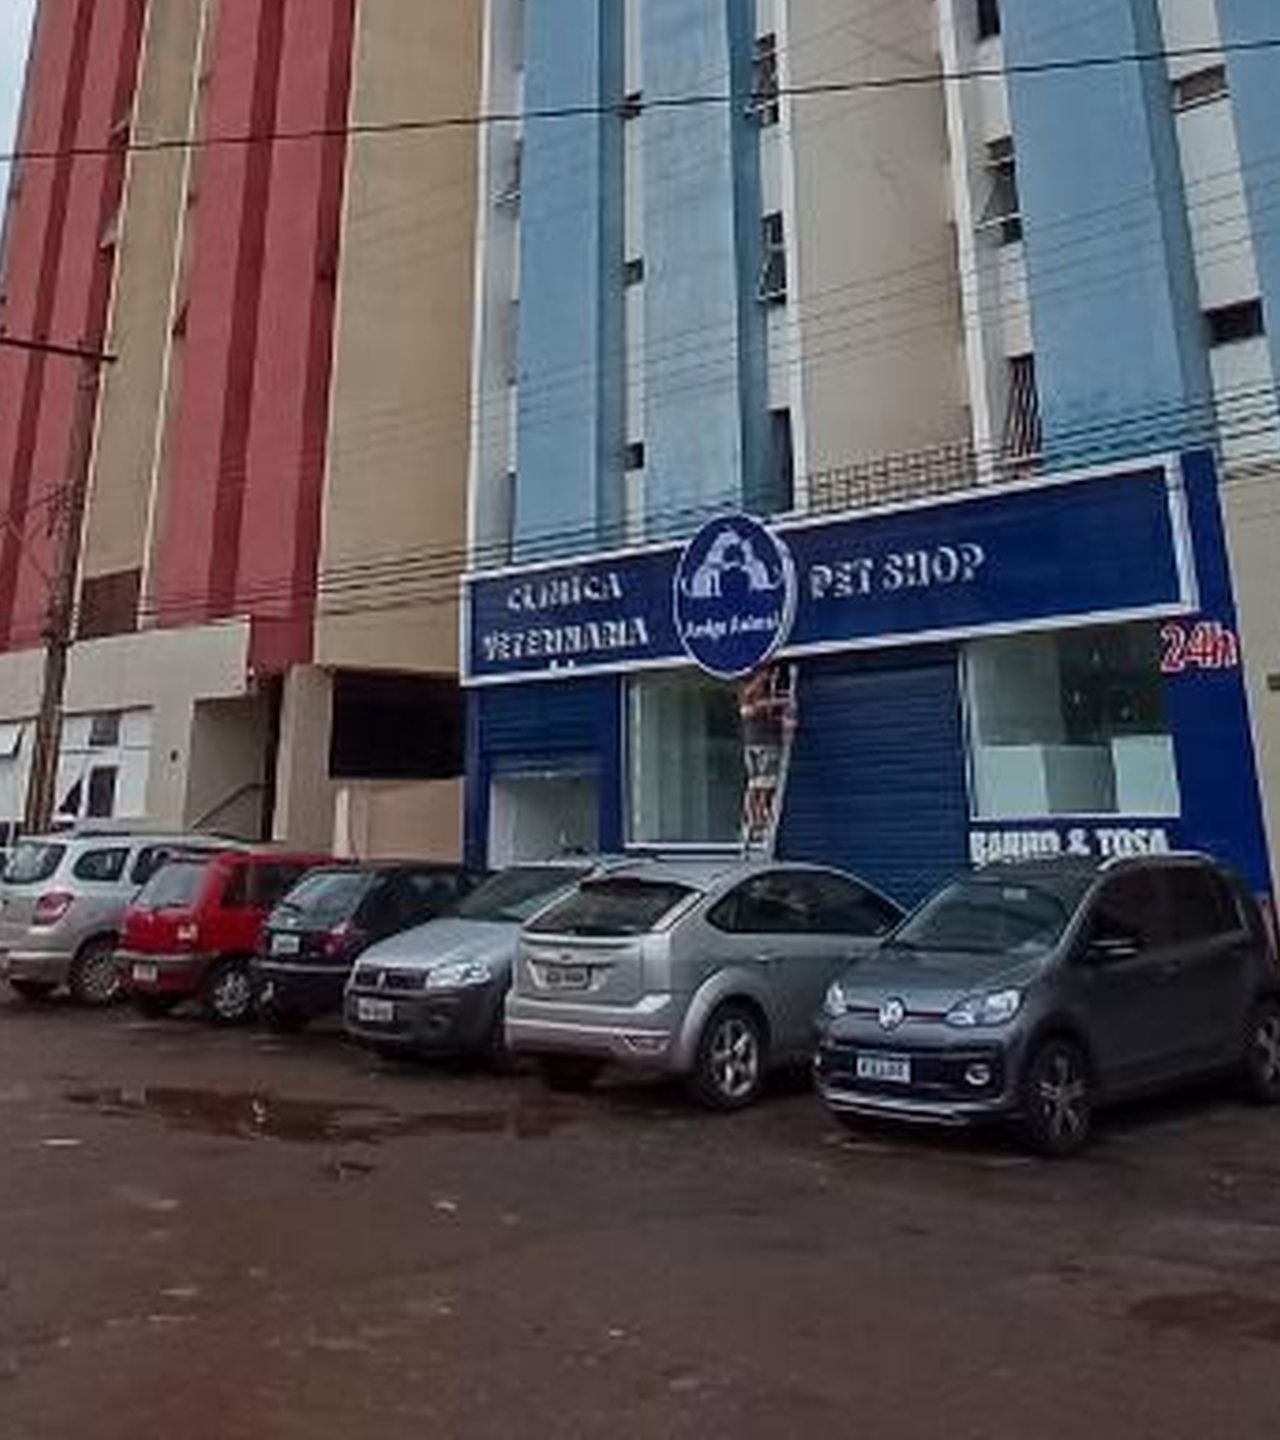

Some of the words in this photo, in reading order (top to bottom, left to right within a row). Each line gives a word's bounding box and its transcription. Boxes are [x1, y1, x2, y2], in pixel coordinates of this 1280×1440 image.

[811, 558, 873, 600] PET
[882, 543, 985, 591] SHOP
[1161, 622, 1238, 672] 24h
[1096, 827, 1169, 859] TOSA
